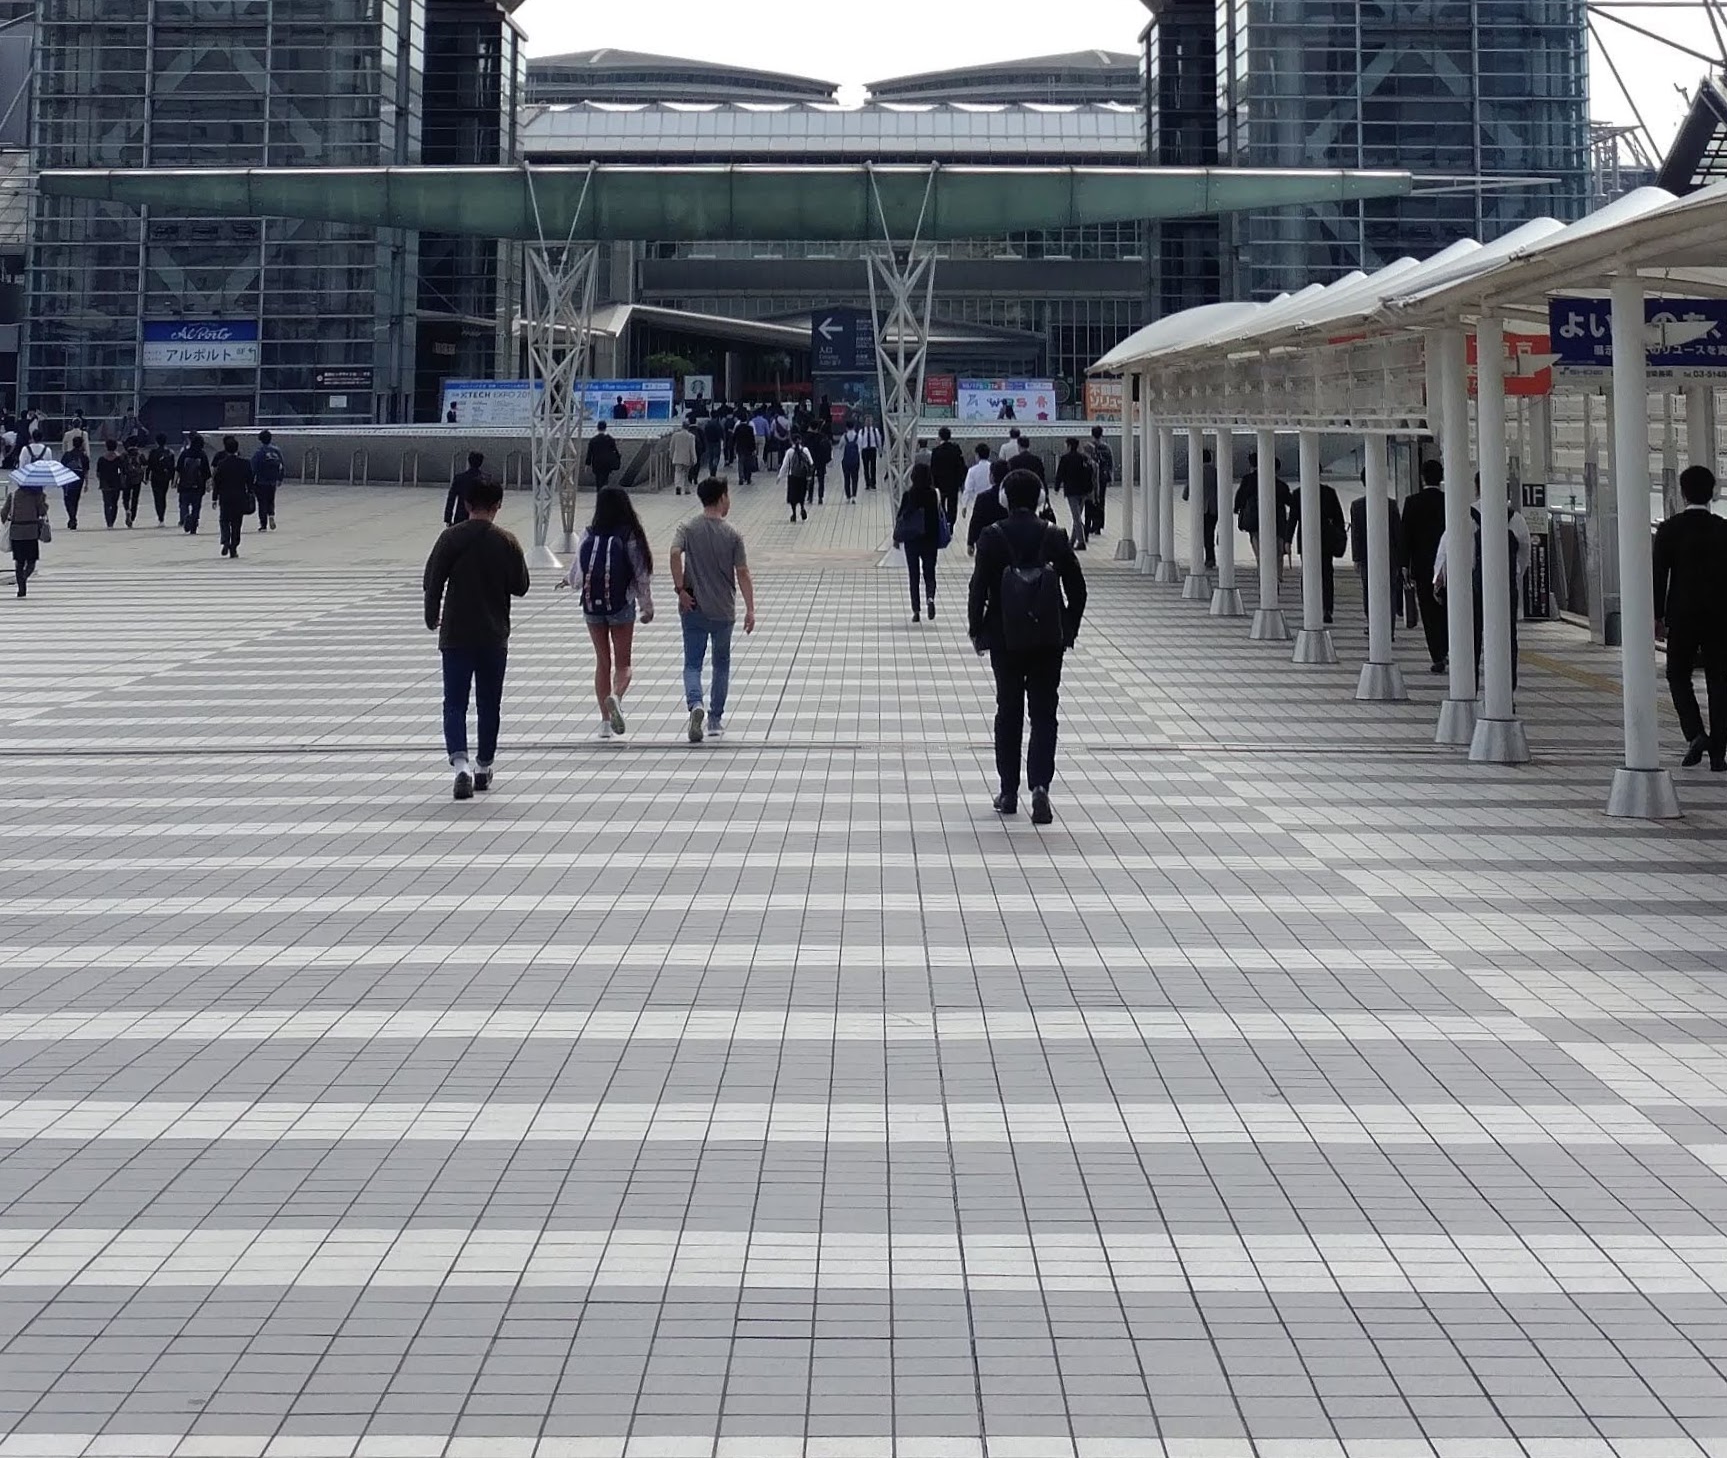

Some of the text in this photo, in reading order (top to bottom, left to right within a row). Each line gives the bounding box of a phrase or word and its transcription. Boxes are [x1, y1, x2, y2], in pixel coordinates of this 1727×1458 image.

[166, 348, 231, 361] アルポルト
[1523, 485, 1544, 506] 1F
